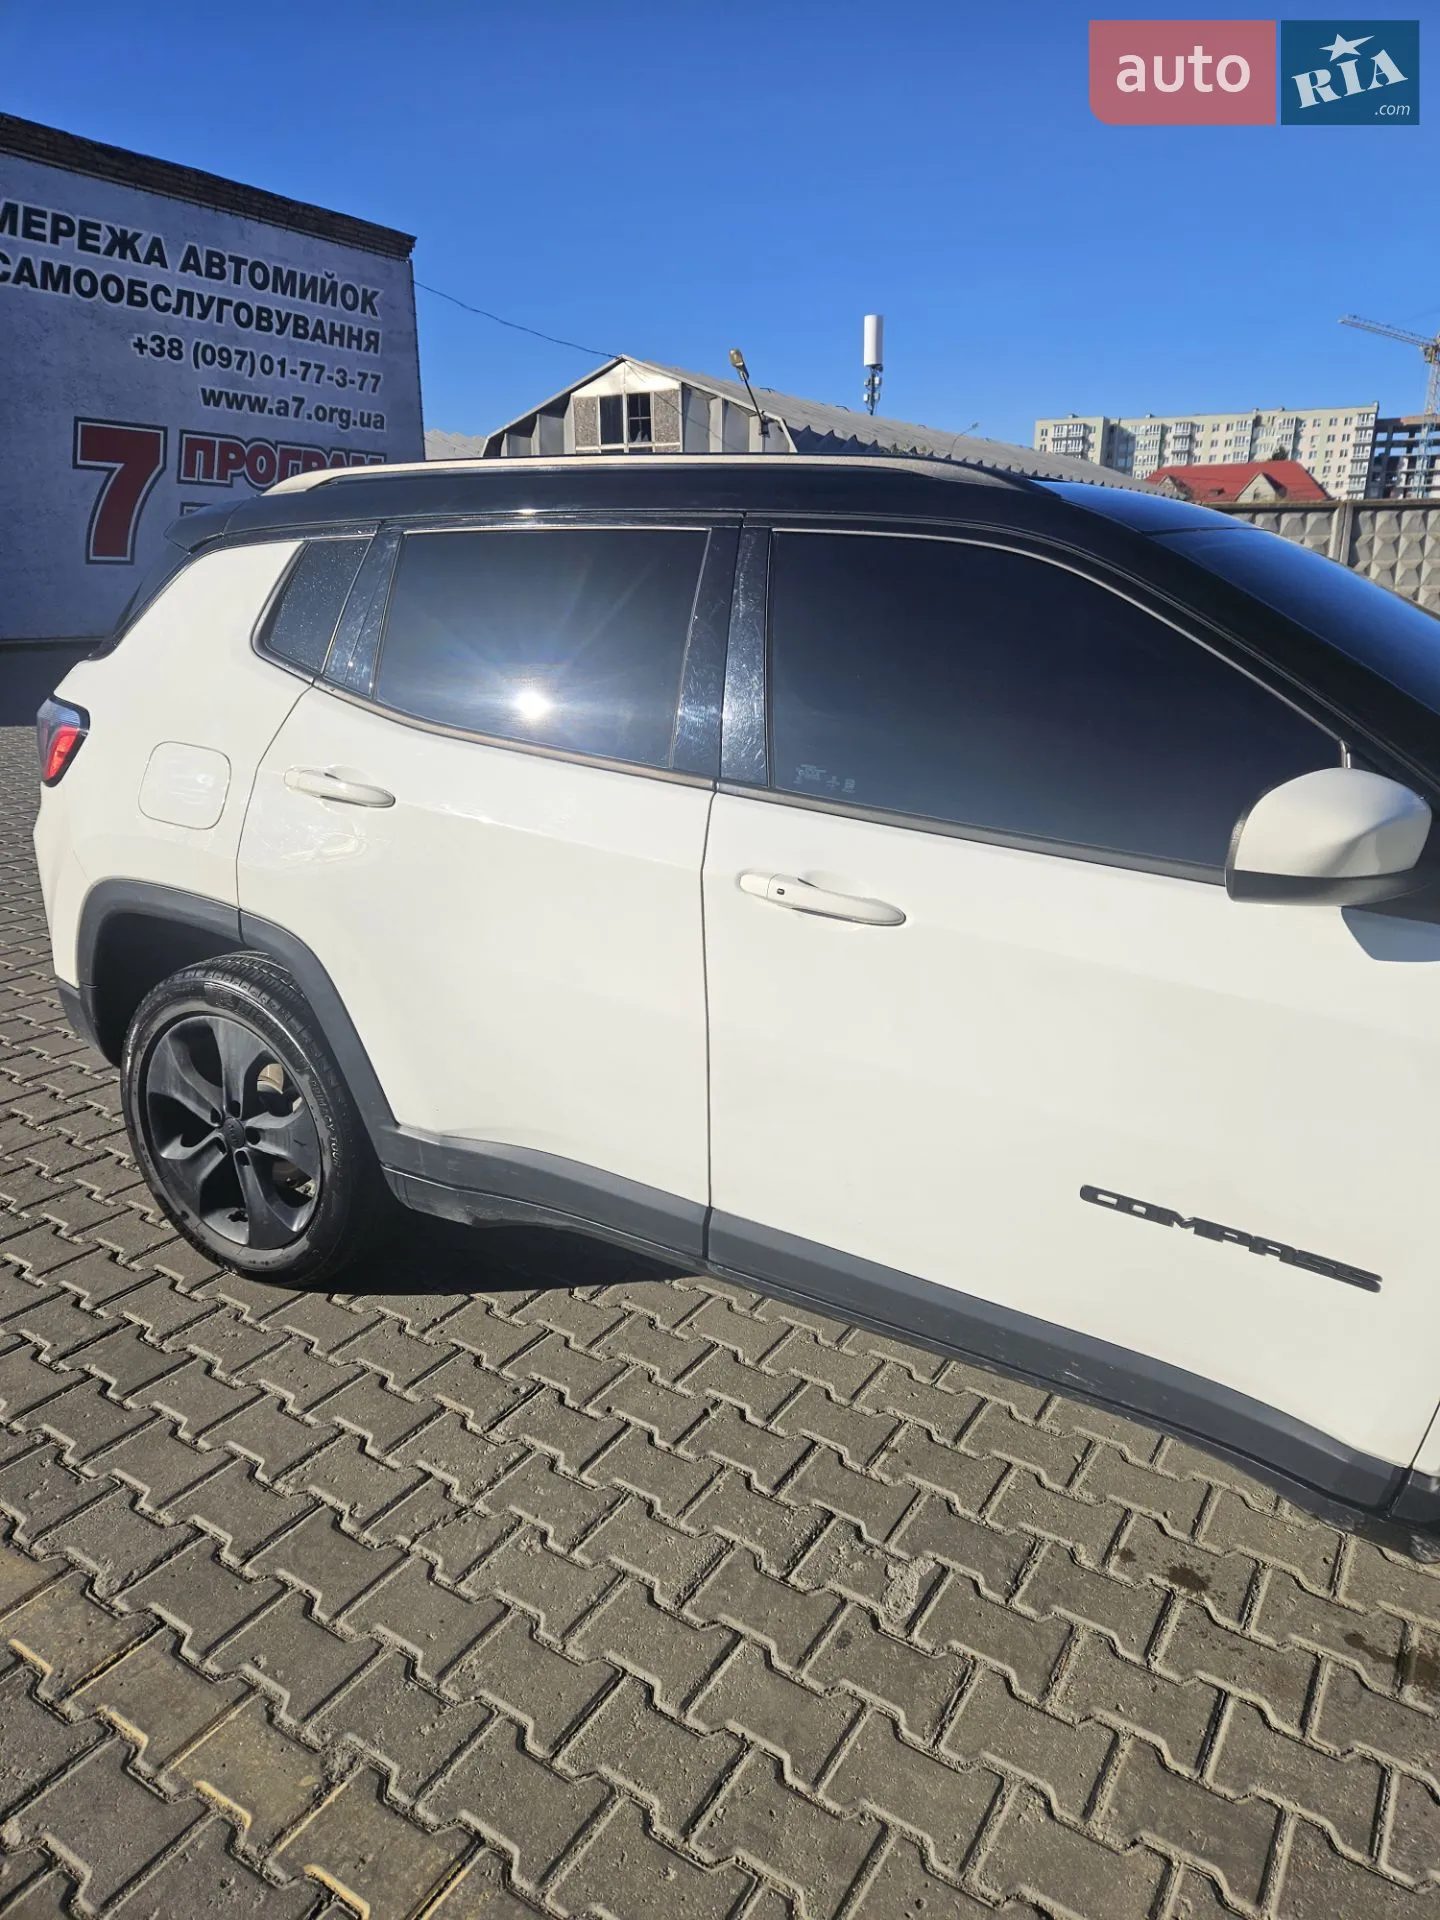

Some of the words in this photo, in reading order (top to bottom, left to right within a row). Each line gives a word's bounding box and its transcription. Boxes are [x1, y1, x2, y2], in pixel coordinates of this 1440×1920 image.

[179, 250, 381, 317] АВТОМИЙОК
[133, 335, 184, 360] +38
[201, 388, 385, 430] www.a7.org.ua
[73, 416, 167, 565] 7
[1080, 1184, 1383, 1293] COMPASS
